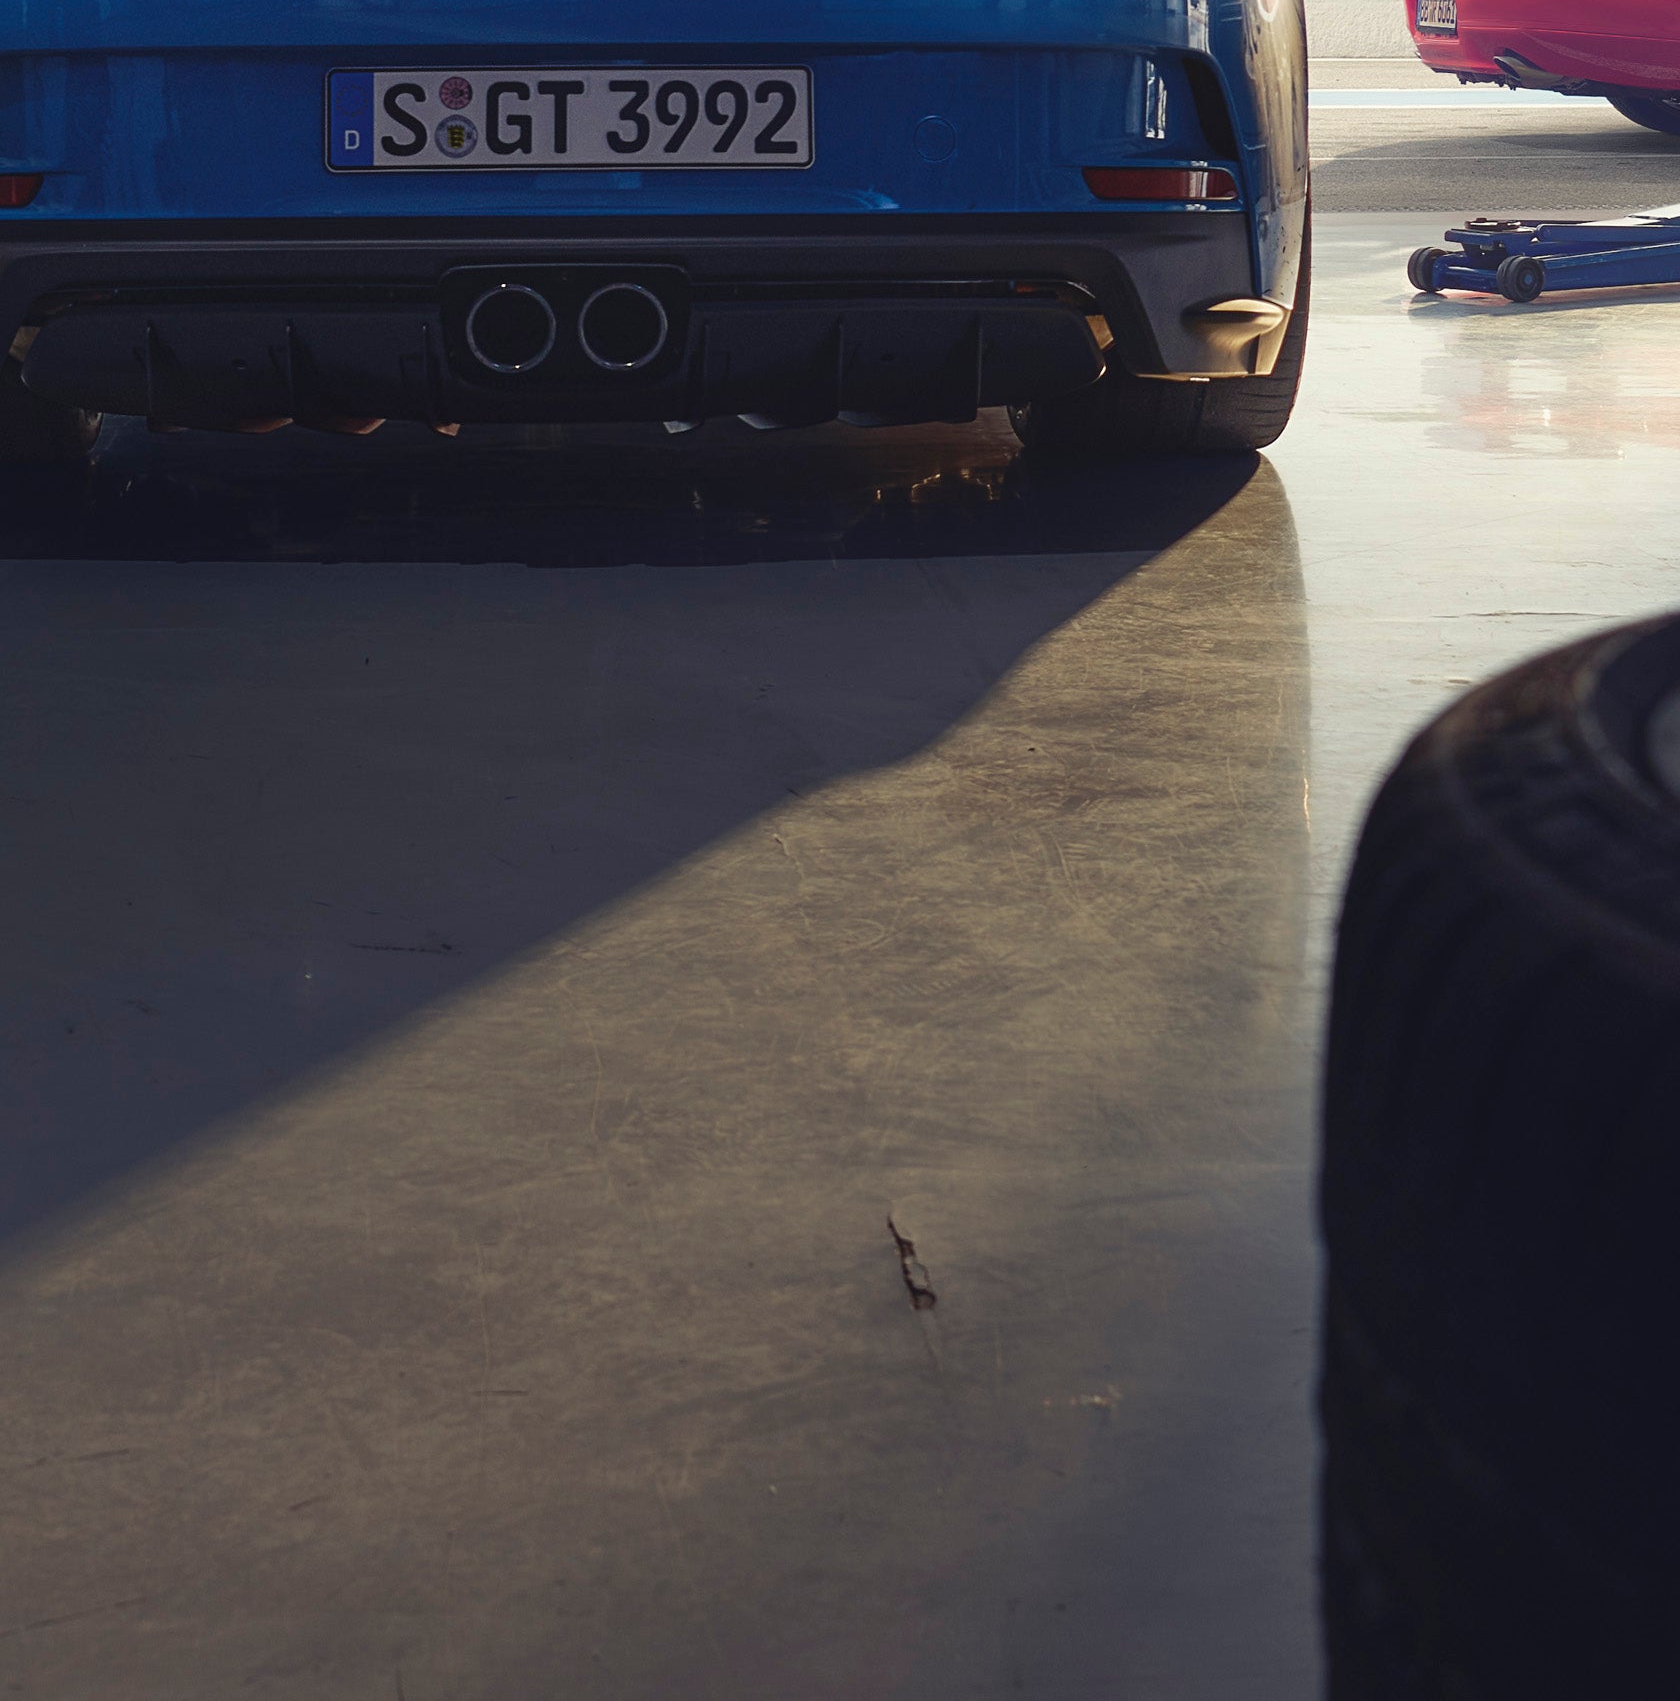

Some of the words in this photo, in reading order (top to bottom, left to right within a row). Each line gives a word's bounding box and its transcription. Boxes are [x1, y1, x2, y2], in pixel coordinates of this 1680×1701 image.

[344, 130, 360, 150] D
[380, 83, 428, 157] S
[485, 80, 585, 156] GT
[606, 79, 798, 155] 3992
